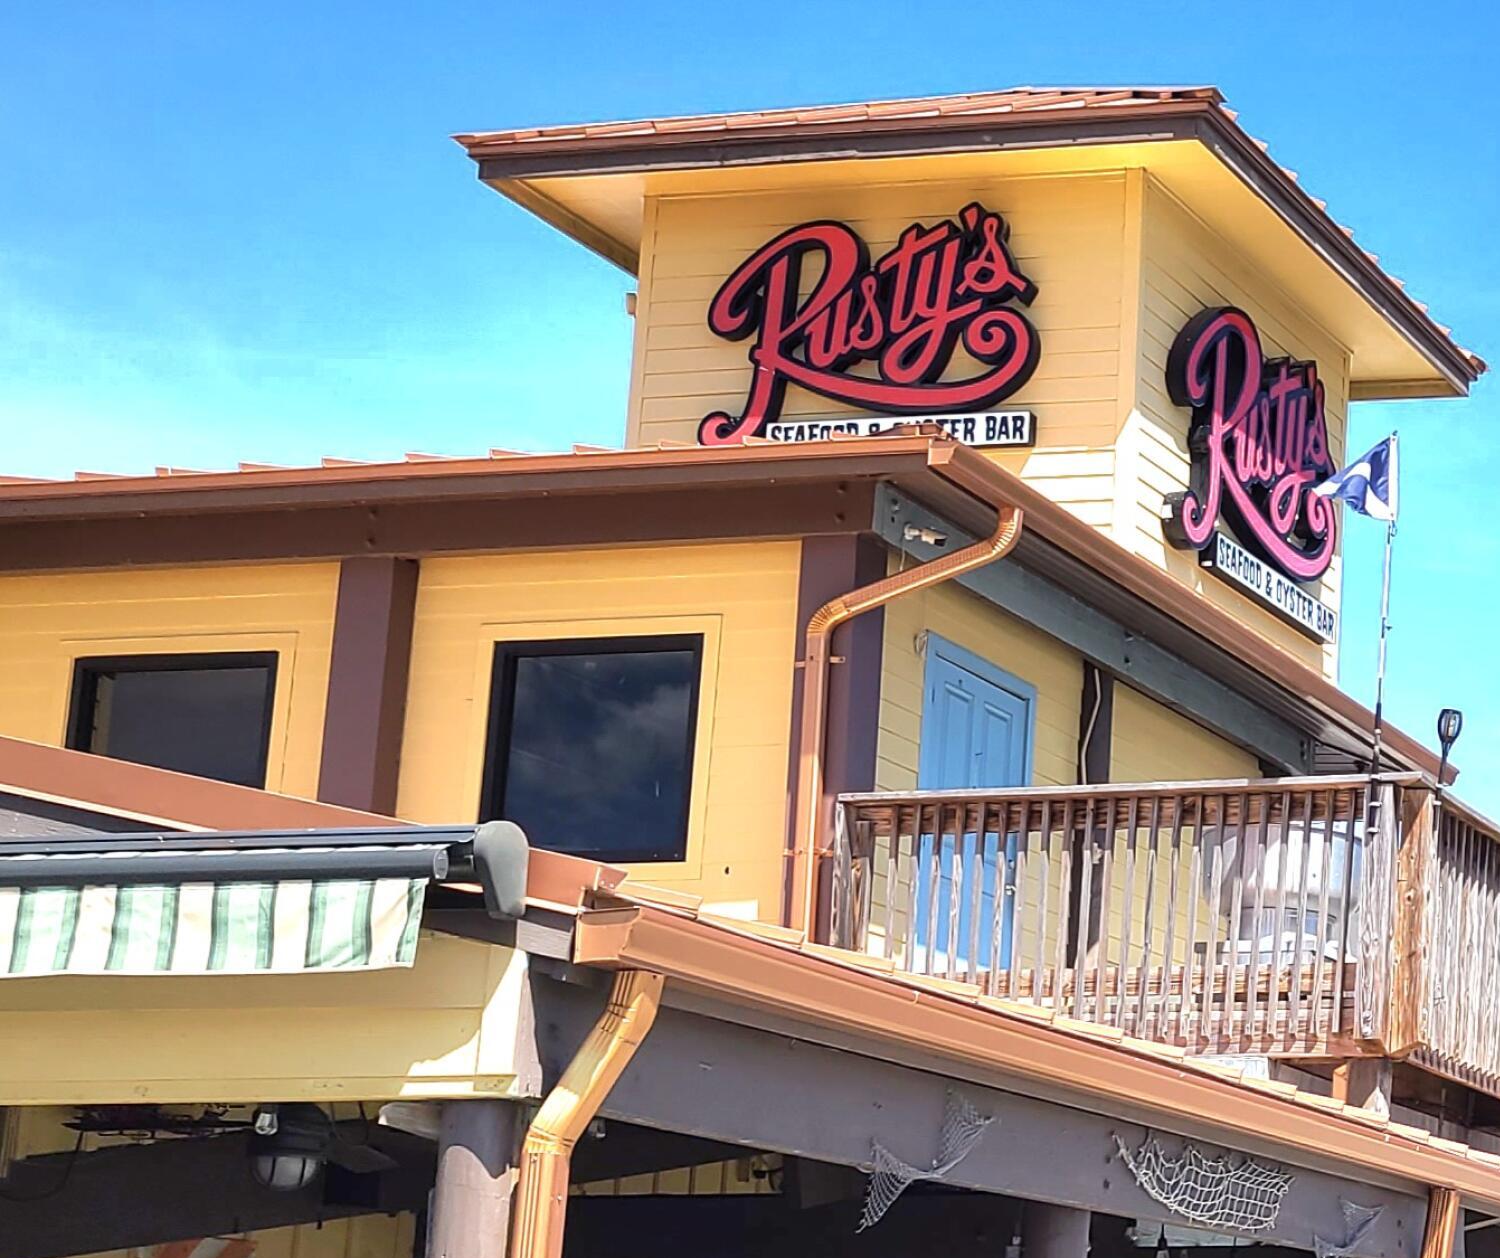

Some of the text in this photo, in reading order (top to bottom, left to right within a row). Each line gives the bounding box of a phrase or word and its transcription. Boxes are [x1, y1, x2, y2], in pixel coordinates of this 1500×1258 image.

[700, 203, 1038, 445] Rusty's
[985, 415, 1025, 441] BAR
[1180, 309, 1336, 580] Rusty's
[1219, 537, 1335, 641] SEAFOOD & OYSTER BAR
